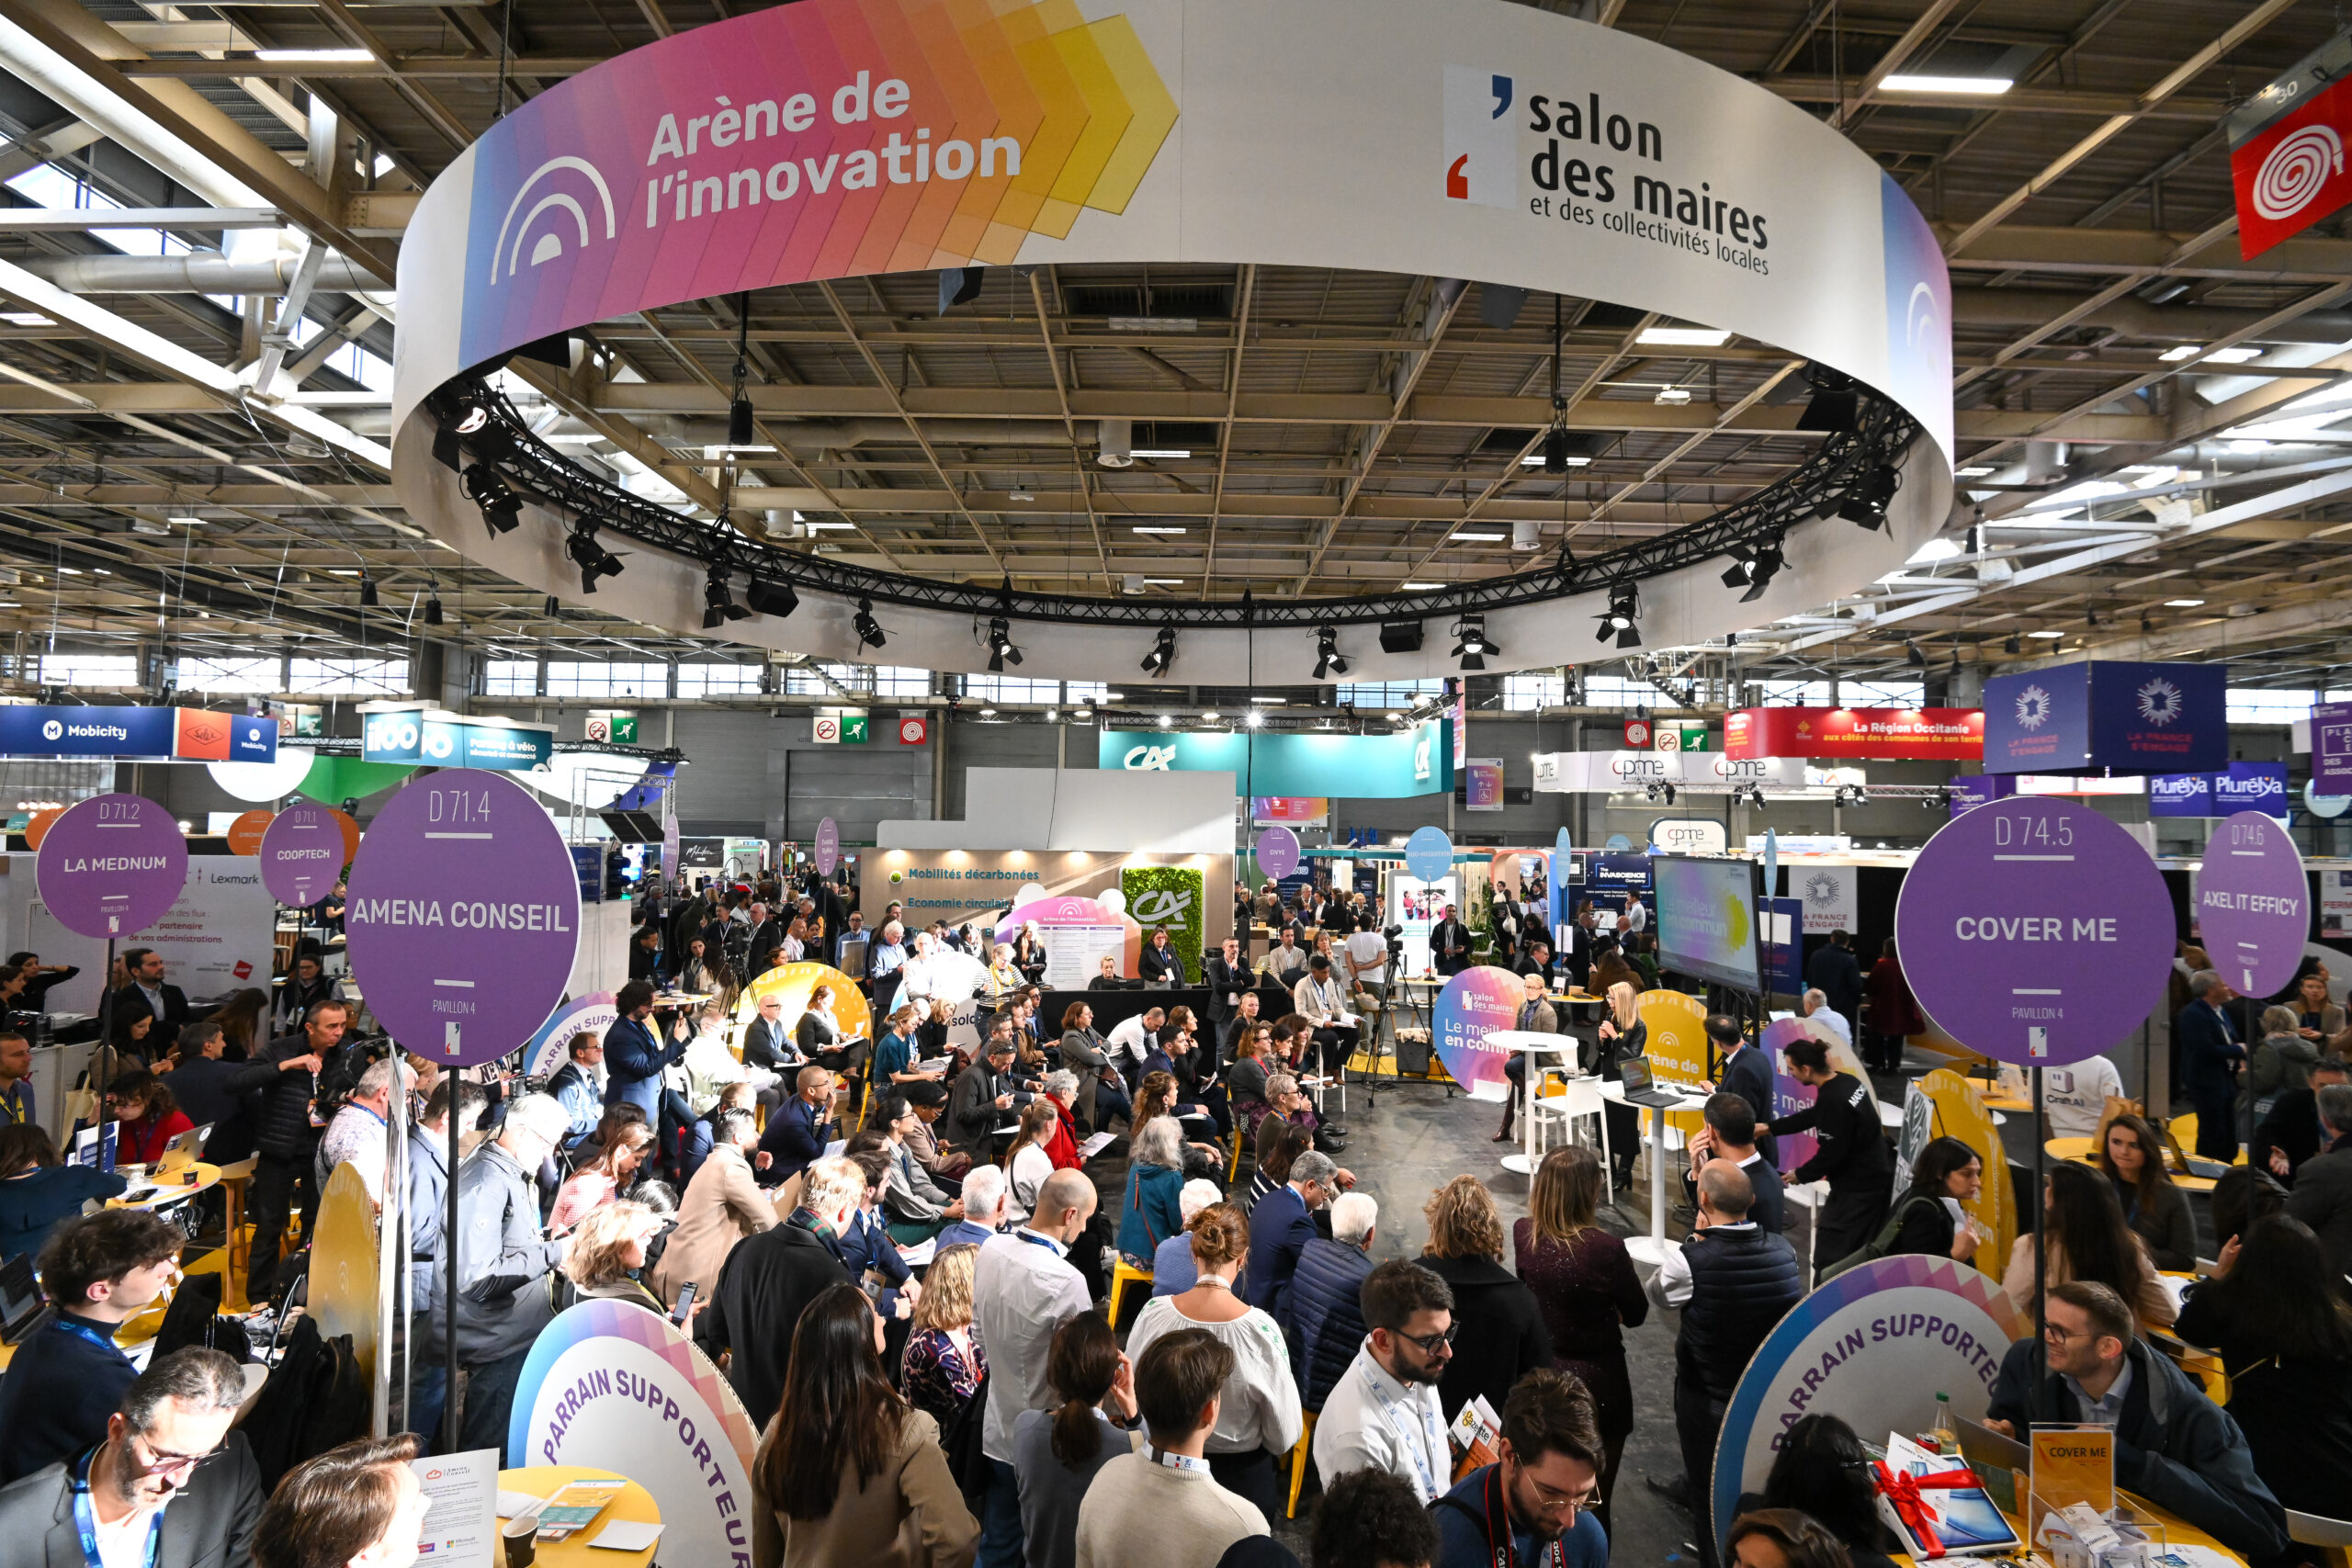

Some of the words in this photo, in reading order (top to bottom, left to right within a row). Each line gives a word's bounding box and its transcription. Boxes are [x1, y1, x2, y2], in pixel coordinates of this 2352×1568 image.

[647, 92, 817, 166] Arène
[832, 70, 910, 125] de
[1530, 93, 1661, 162] salon
[647, 128, 1021, 229] l'innovation
[1531, 139, 1615, 202] des
[1634, 182, 1768, 252] maires
[1531, 196, 1551, 218] et
[1559, 198, 1594, 225] des
[1602, 211, 1709, 256] collectivités
[1717, 238, 1769, 276] locales
[68, 724, 127, 739] Mobicity
[1854, 722, 1868, 733] La
[1871, 722, 1911, 735] Région
[1914, 722, 1969, 734] Occitanie
[2021, 735, 2059, 746] FRANCE
[2127, 732, 2143, 741] LA
[2146, 733, 2193, 743] FRANCE
[241, 741, 267, 751] Mobicity
[516, 742, 537, 751] vélo
[1612, 759, 1664, 780] cpme
[1714, 759, 1766, 781] cpme
[2151, 776, 2208, 797] Plurélya
[2215, 776, 2283, 797] Plurélya
[99, 803, 109, 819] D
[114, 803, 141, 819] 71.2
[430, 790, 443, 822] D
[449, 790, 491, 822] 71.4
[295, 811, 301, 823] D
[302, 811, 316, 823] 71.1
[1668, 828, 1704, 846] cpme
[1996, 817, 2011, 846] D
[2019, 817, 2074, 846] 74.5
[2232, 825, 2240, 845] D
[2242, 825, 2265, 846] 74.6
[277, 849, 331, 861] COOPTECH
[64, 858, 87, 873] LA
[92, 856, 166, 872] MEDNUM
[210, 874, 259, 885] Lexmark
[909, 869, 962, 880] Mobilités
[966, 869, 1039, 880] décarbonées
[100, 905, 125, 913] PAVILLON
[908, 897, 962, 909] Economie
[966, 897, 1011, 908] circulair
[2203, 890, 2234, 909] AXEL
[2236, 893, 2249, 910] IT
[2251, 895, 2299, 917] EFFICY
[2323, 900, 2352, 908] PERM
[176, 909, 190, 918] des
[351, 898, 444, 927] AMENA
[450, 901, 570, 932] CONSEIL
[159, 922, 203, 931] partenaire
[1956, 917, 2064, 942] COVER
[2073, 919, 2118, 942] ME
[156, 935, 222, 943] administrations
[1474, 993, 1494, 1002] salon
[433, 999, 469, 1014] PAVILLON
[470, 1001, 476, 1015] 4
[1474, 1000, 1487, 1010] des
[1488, 1003, 1514, 1012] maires
[2012, 1007, 2056, 1020] PAVILLON
[2057, 1008, 2064, 1020] 4
[1445, 1018, 1462, 1033] Le
[1466, 1023, 1499, 1036] meill
[540, 1022, 582, 1076] PARRAIN
[584, 1014, 616, 1028] SUPP
[1445, 1035, 1464, 1048] en
[1645, 1051, 1679, 1070] rène
[1681, 1058, 1700, 1075] de
[1782, 1094, 1815, 1112] meil
[2050, 1448, 2086, 1458] COVER
[2090, 1448, 2107, 1457] ME
[544, 1368, 612, 1466] PARRAIN
[616, 1369, 752, 1568] SUPPORTEUR
